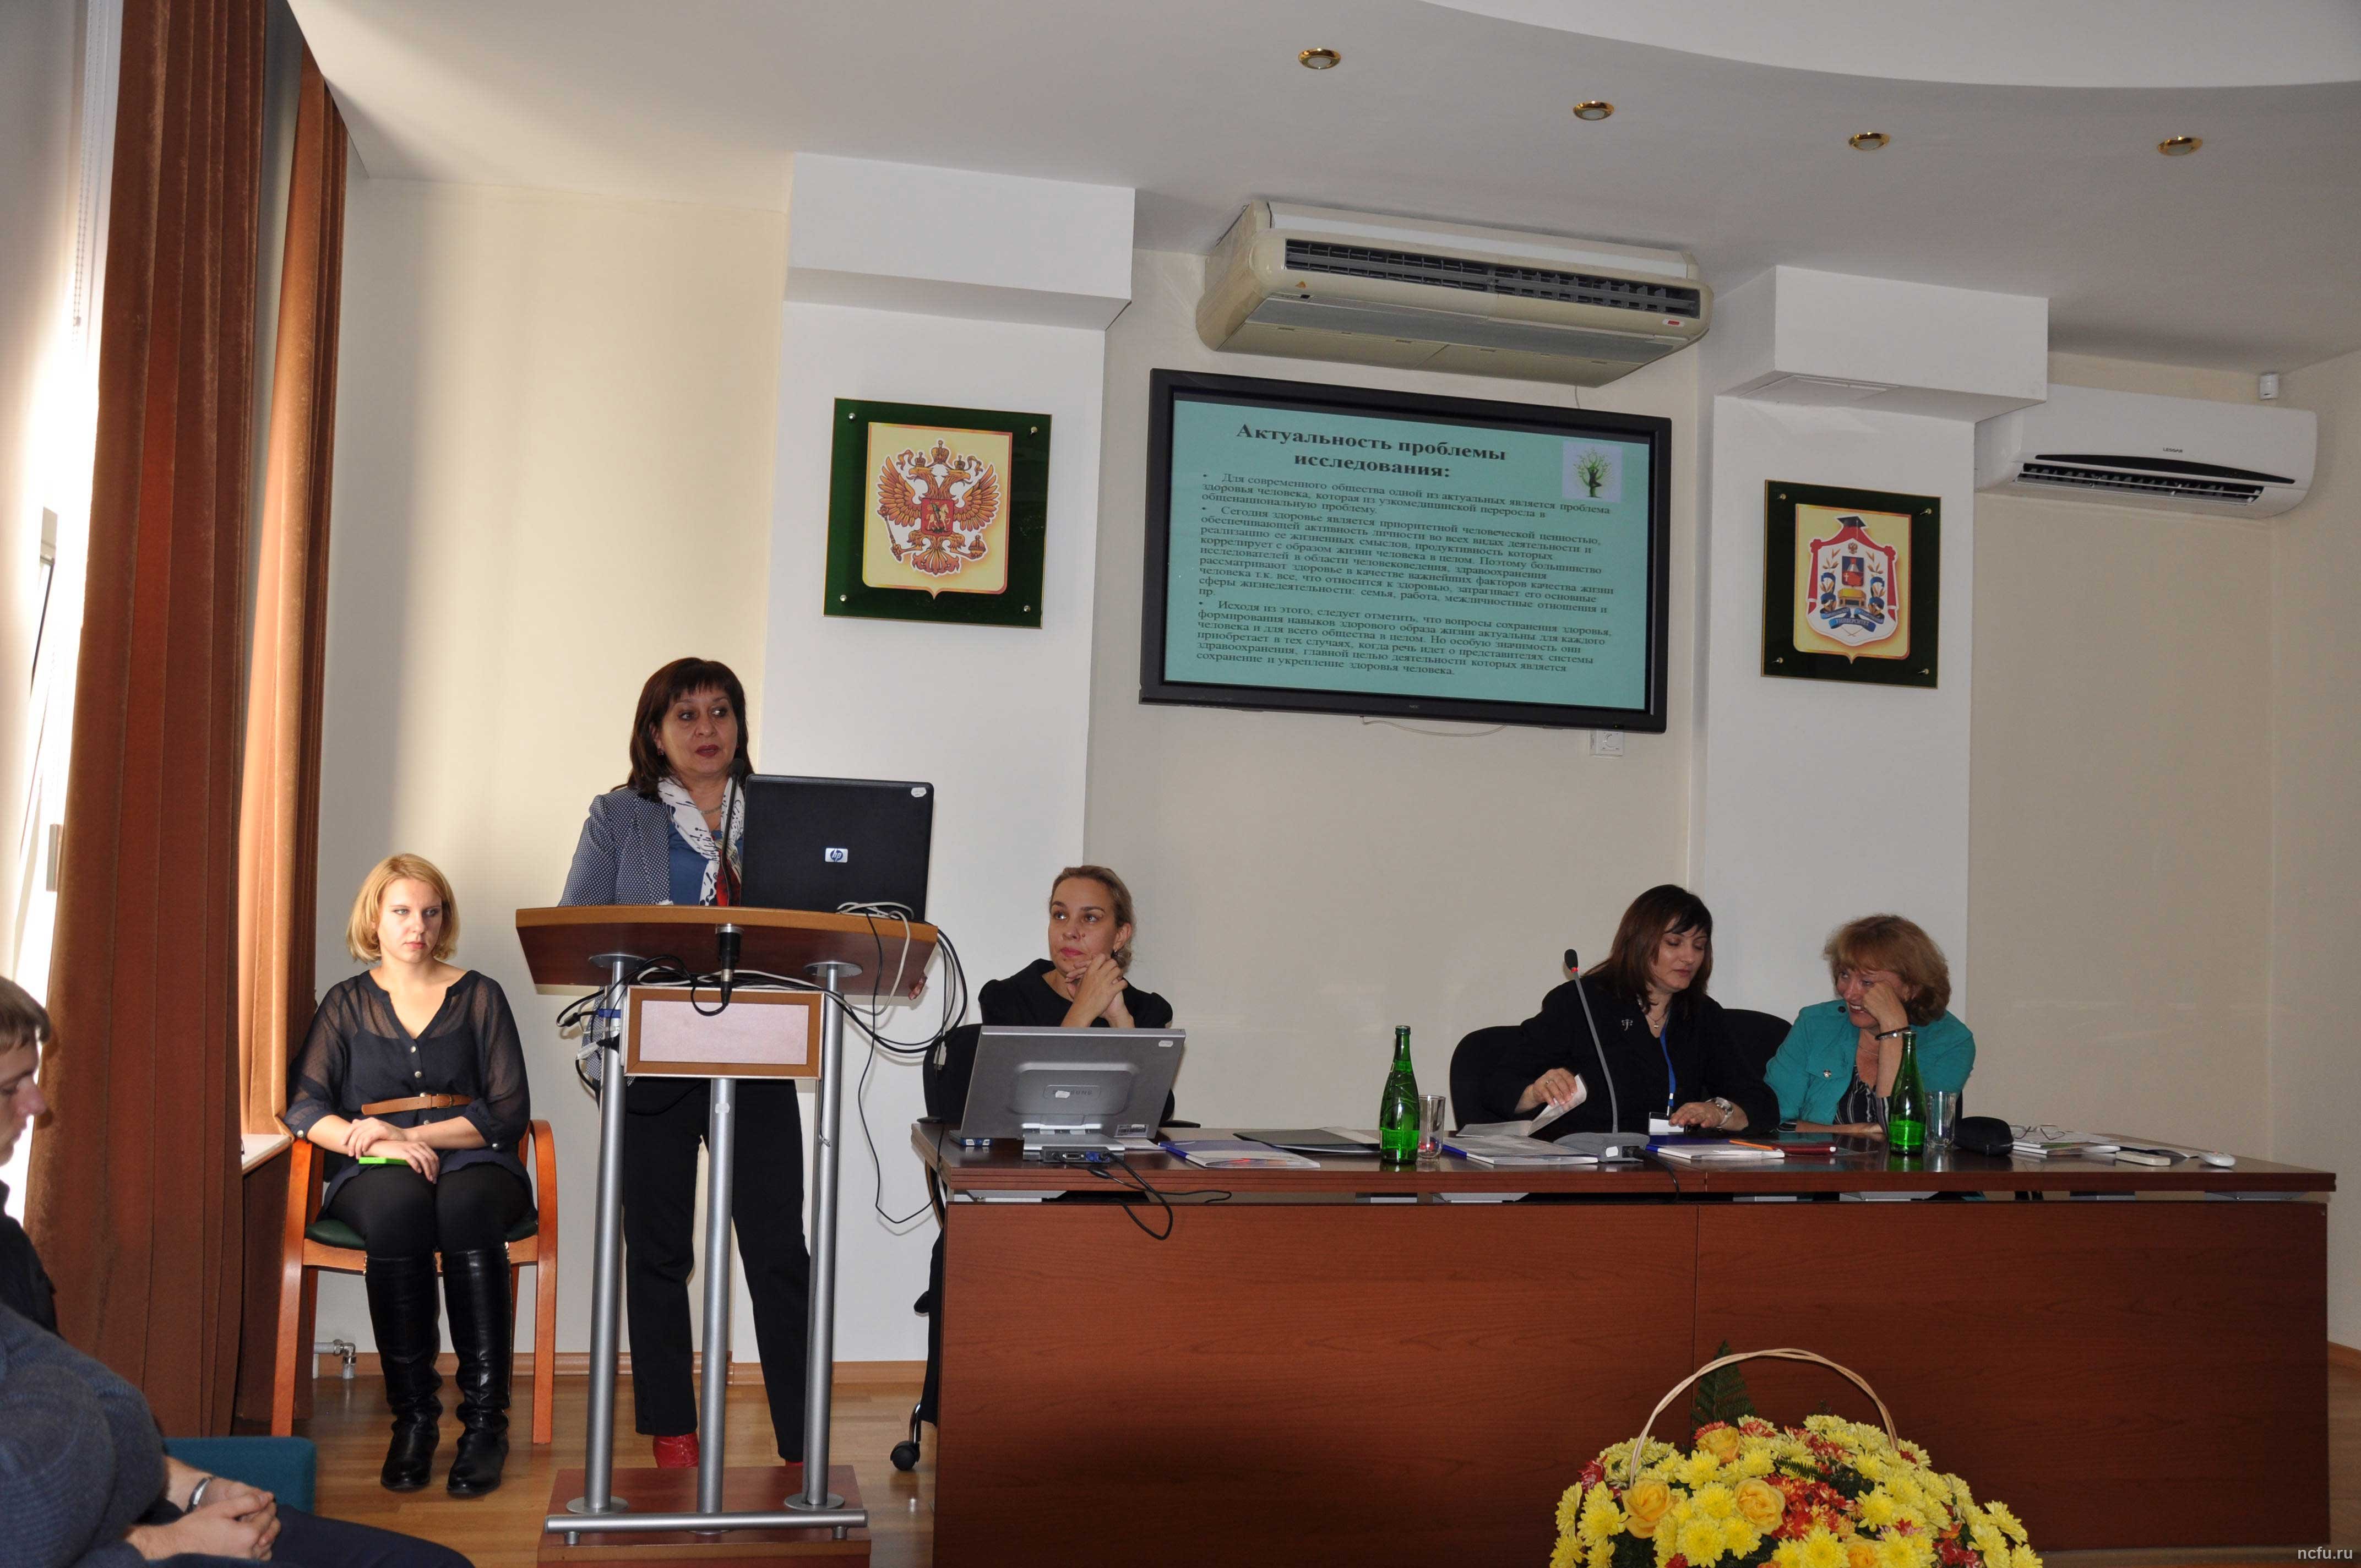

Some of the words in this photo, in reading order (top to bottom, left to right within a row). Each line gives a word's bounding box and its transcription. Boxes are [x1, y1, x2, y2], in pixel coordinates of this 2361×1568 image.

[1236, 424, 1392, 450] Актуальность
[1399, 442, 1505, 460] проблемы
[1294, 455, 1449, 478] исследования:
[1201, 492, 1317, 510] общенациональную
[1203, 484, 1253, 494] здоровья
[1316, 493, 1359, 505] которая
[1481, 507, 1535, 517] переросла
[1222, 473, 1244, 483] Для
[1248, 478, 1327, 489] современного
[1331, 483, 1385, 494] общества
[1389, 489, 1422, 498] одной
[1441, 494, 1505, 505] актуальных
[1509, 499, 1555, 509] является
[1560, 504, 1610, 514] проблема
[1201, 515, 1300, 530] обеспечивающей
[1304, 525, 1368, 536] активность
[1372, 530, 1425, 540] личности
[1473, 538, 1504, 546] видах
[1508, 541, 1580, 553] деятельности
[1221, 506, 1268, 518] Сегодня
[1272, 512, 1323, 523] здоровье
[1326, 516, 1375, 526] является
[1380, 521, 1458, 533] приоритетной
[1462, 527, 1535, 539] человеческой
[1200, 527, 1270, 538] реализацию
[1290, 533, 1354, 545] жизненных
[1415, 543, 1503, 556] продуктивность
[1508, 551, 1553, 561] которых
[1200, 537, 1273, 549] коррелирует
[1286, 542, 1331, 553] образом
[1336, 547, 1372, 556] жизни
[1376, 551, 1426, 560] человека
[1479, 557, 1527, 570] Поэтому
[1531, 559, 1602, 574] большинство
[1200, 545, 1289, 560] исследователей
[1304, 554, 1348, 564] области
[1455, 567, 1547, 580] здравоохранения
[1200, 558, 1287, 570] рассматривают
[1292, 564, 1342, 574] здоровье
[1356, 569, 1404, 578] качестве
[1408, 573, 1472, 584] важнейших
[1476, 576, 1527, 589] факторов
[1531, 582, 1576, 591] качества
[1199, 568, 1251, 578] человека
[1325, 577, 1383, 587] относится
[1457, 586, 1520, 597] затрагивает
[1544, 594, 1596, 603] основные
[1199, 576, 1236, 587] сферы
[1445, 596, 1533, 608] межличностные
[1537, 603, 1597, 612] отношения
[1198, 609, 1283, 623] формирования
[1287, 617, 1335, 627] навыков
[1340, 621, 1396, 630] здорового
[1400, 624, 1436, 636] образа
[1478, 630, 1535, 640] актуальны
[1562, 636, 1605, 645] каждого
[1218, 601, 1259, 611] Исходя
[1317, 609, 1360, 619] следует
[1445, 618, 1492, 628] вопросы
[1496, 622, 1557, 633] сохранения
[1198, 622, 1249, 631] человека
[1321, 629, 1375, 639] общества
[1430, 635, 1446, 644] Но
[1450, 638, 1491, 649] особую
[1495, 641, 1557, 652] значимость
[1198, 632, 1269, 643] приобретает
[1392, 645, 1417, 653] речь
[1459, 649, 1543, 661] представителях
[1548, 656, 1593, 664] системы
[1196, 653, 1263, 663] сохранение
[1278, 658, 1345, 668] укрепление
[1349, 662, 1398, 672] здоровья
[1303, 647, 1348, 658] главной
[1353, 652, 1388, 660] целью
[1391, 655, 1466, 666] деятельности
[1471, 660, 1517, 669] которых
[1520, 663, 1566, 672] является
